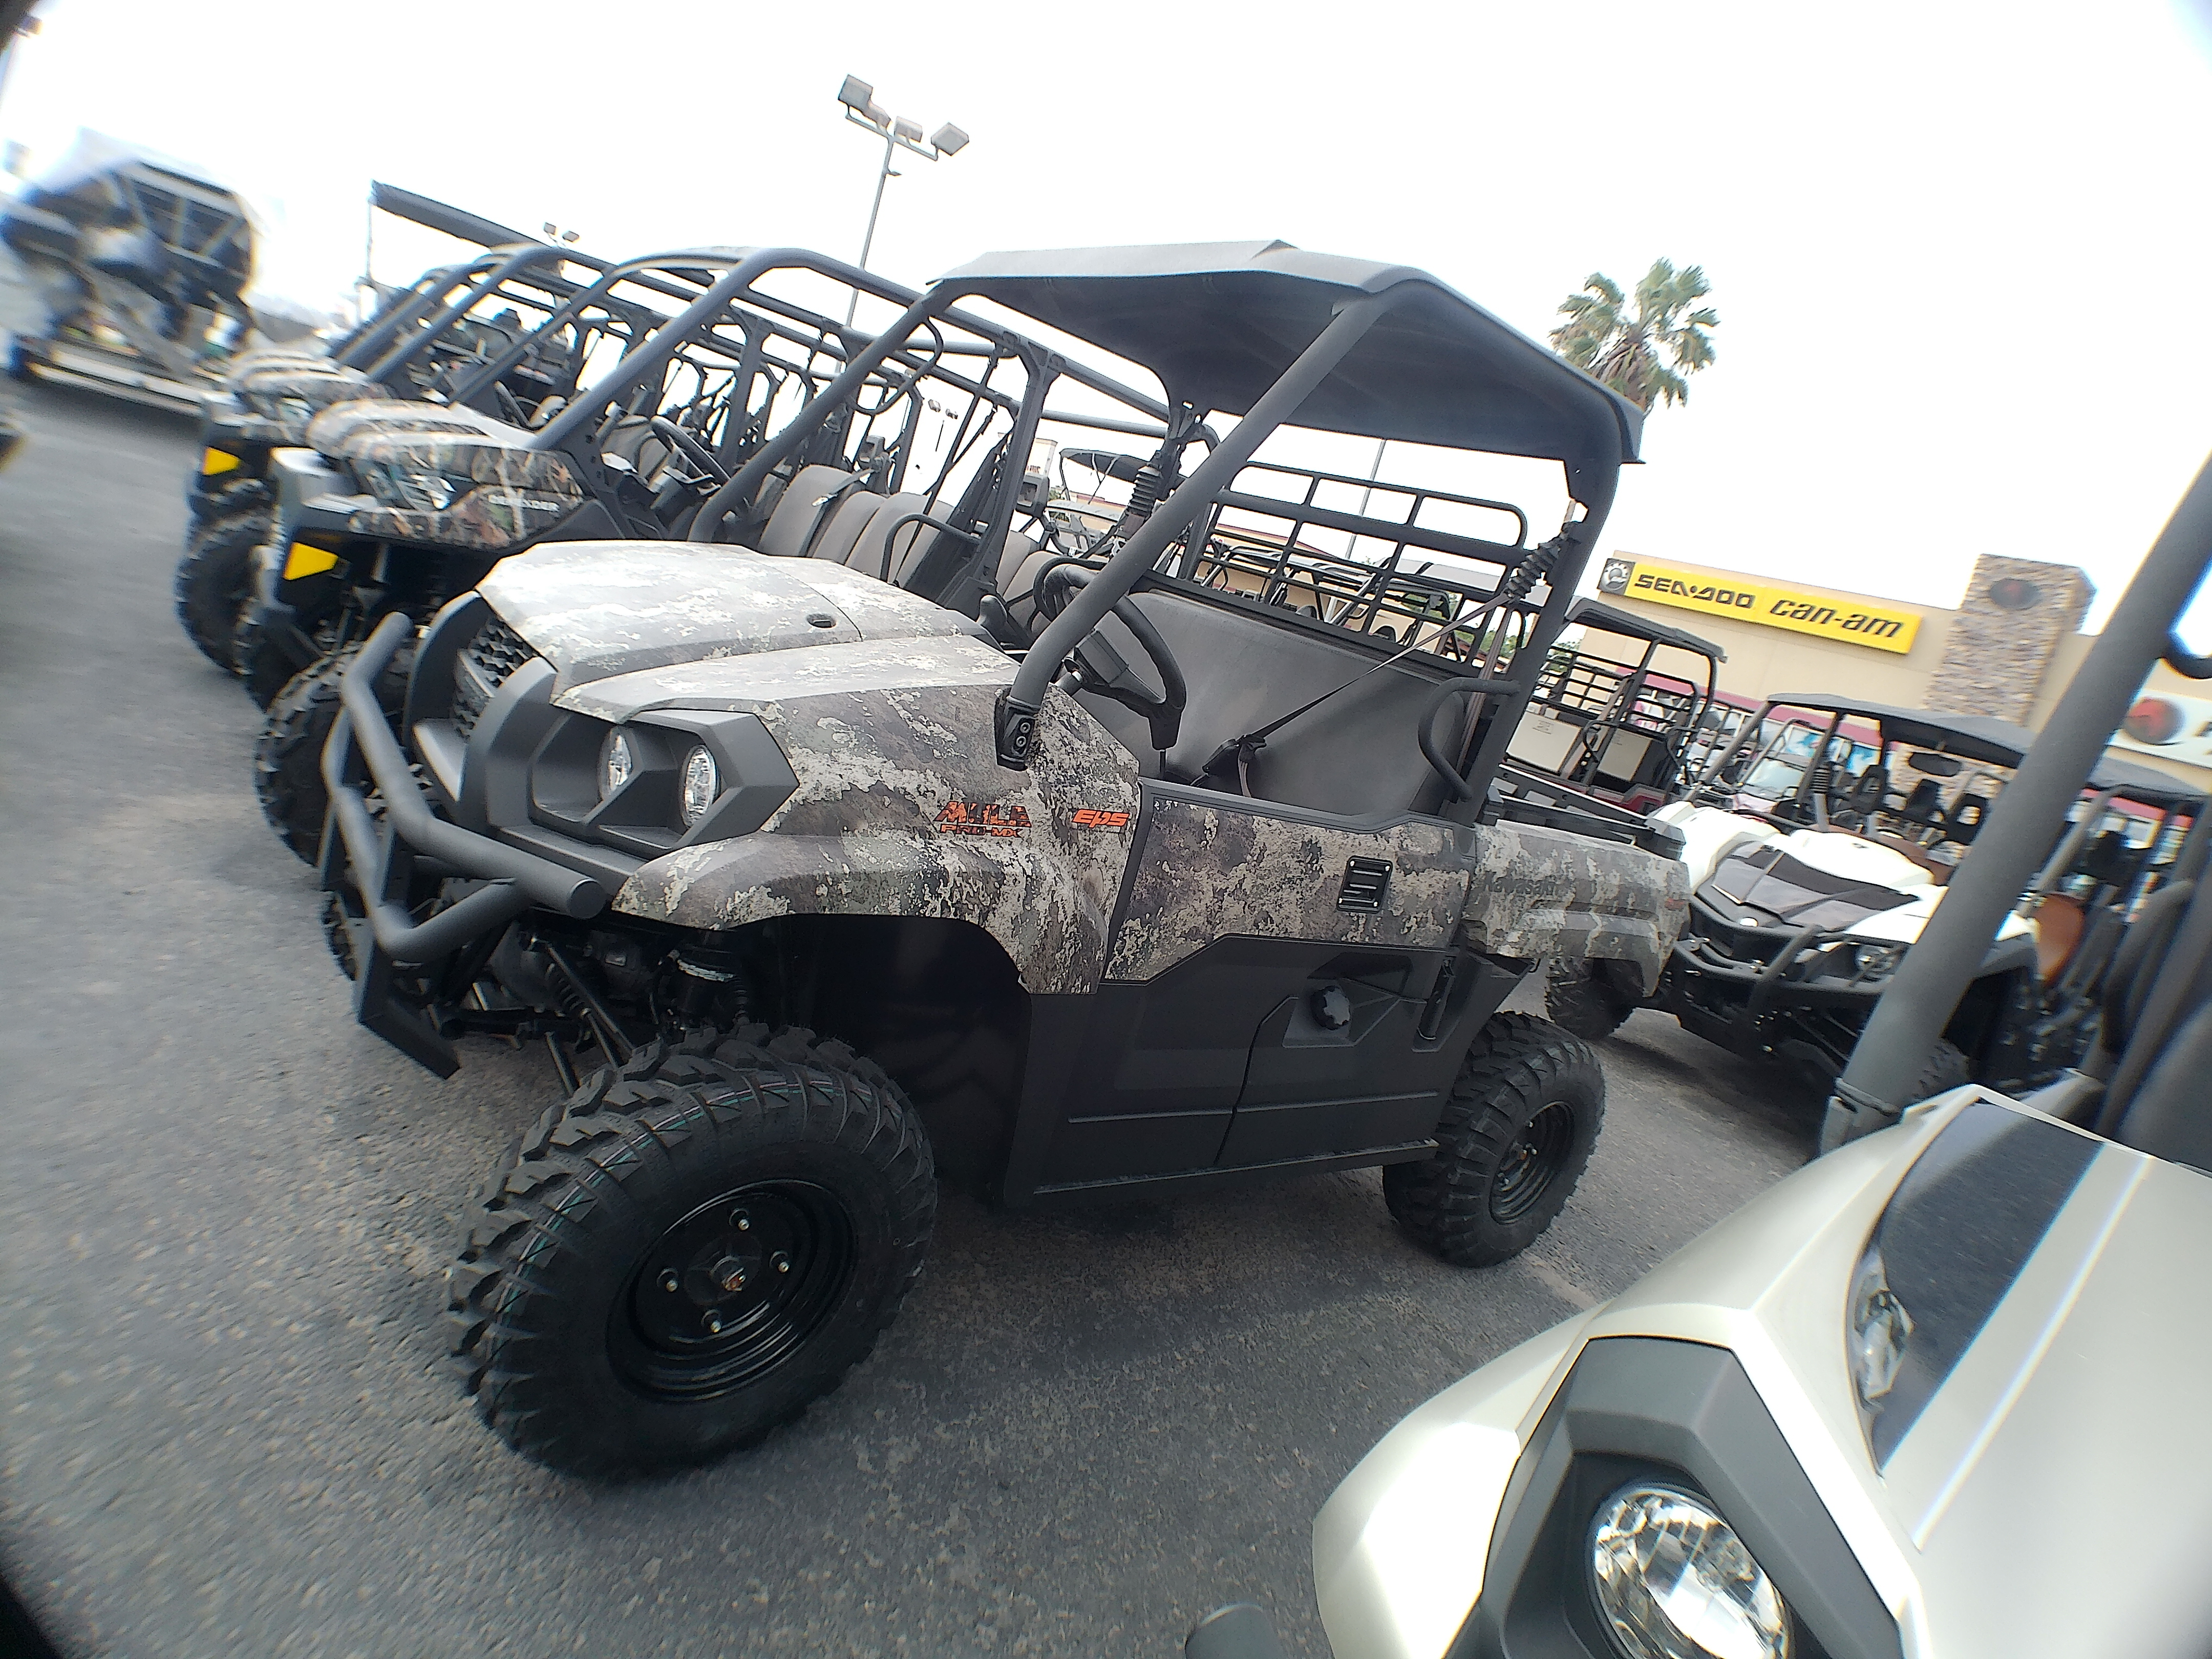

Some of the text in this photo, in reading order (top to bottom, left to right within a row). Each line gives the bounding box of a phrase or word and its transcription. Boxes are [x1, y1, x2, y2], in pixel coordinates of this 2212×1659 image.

[1770, 599, 1903, 638] can-am
[932, 801, 1032, 827] MULE
[940, 824, 1023, 838] PRO-MX
